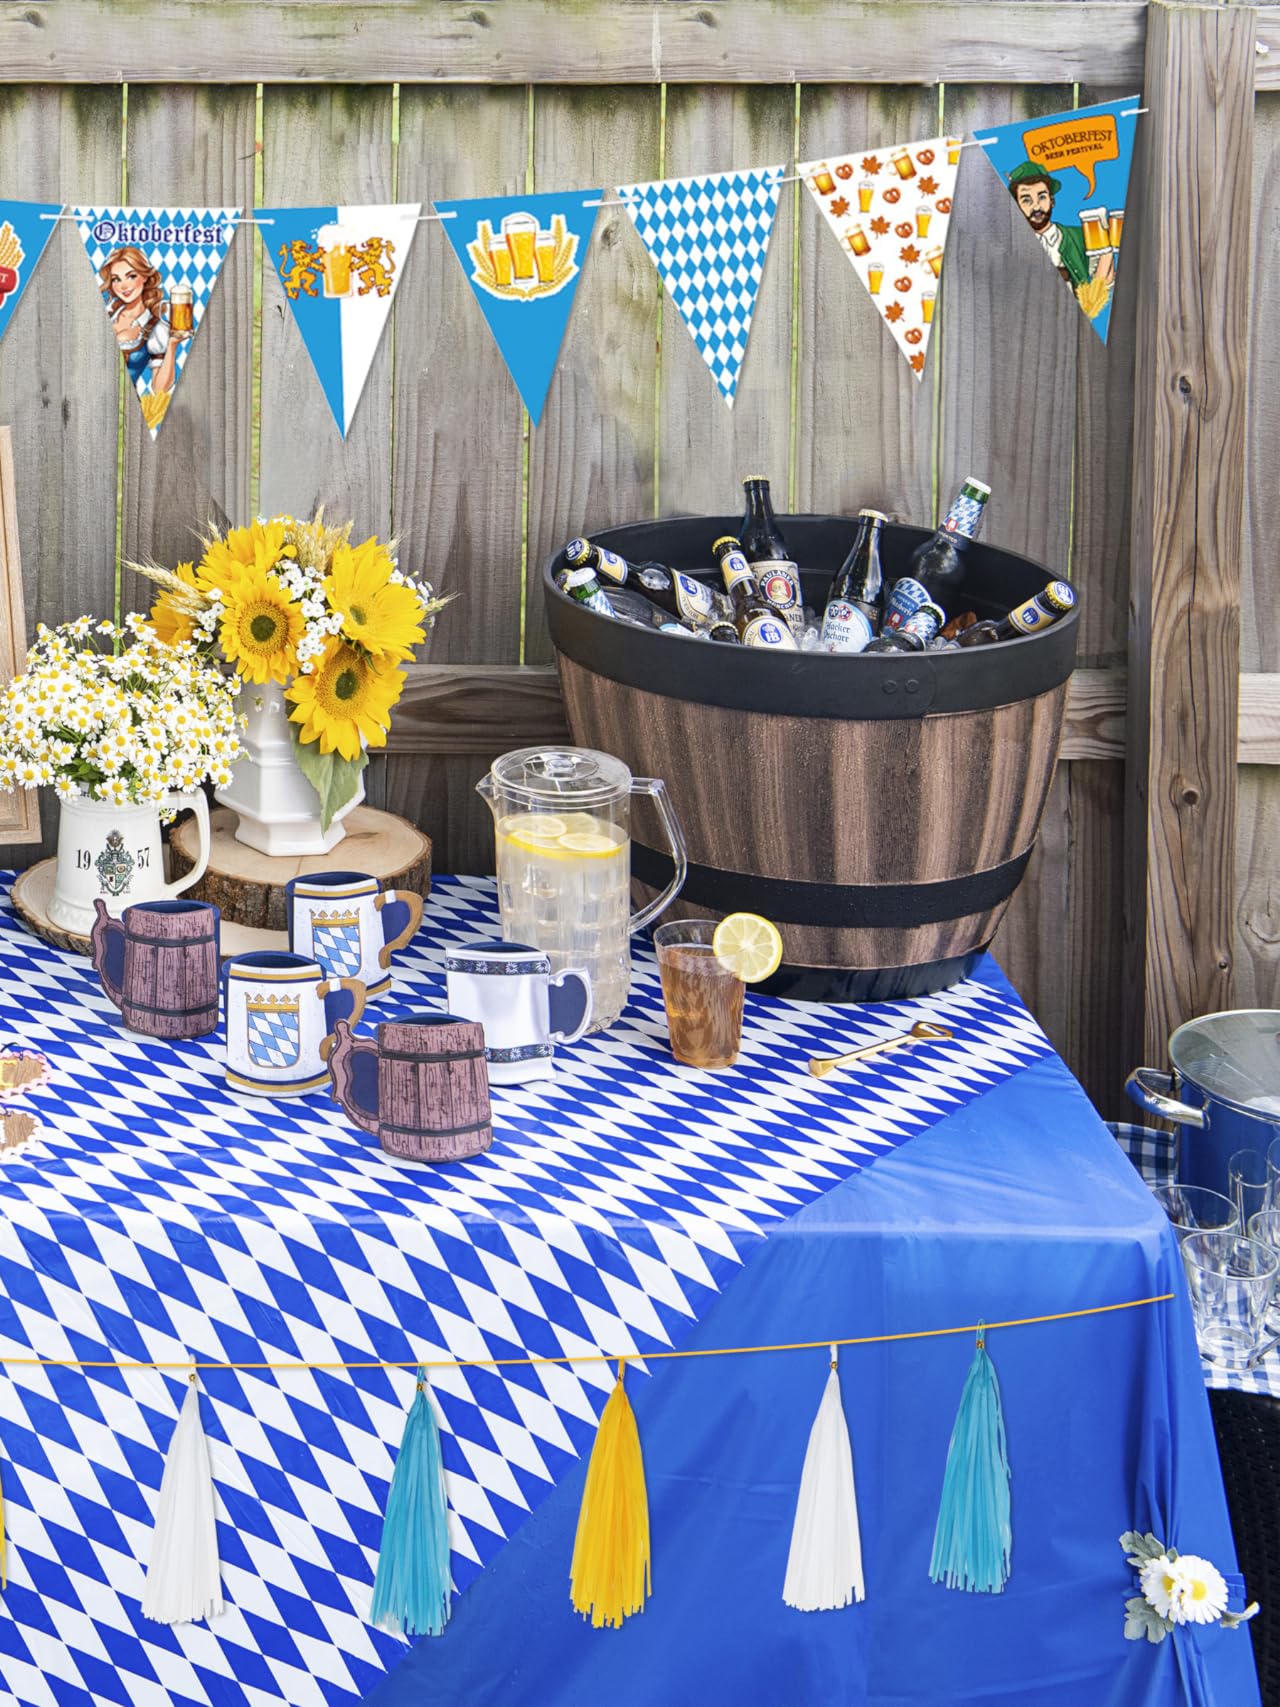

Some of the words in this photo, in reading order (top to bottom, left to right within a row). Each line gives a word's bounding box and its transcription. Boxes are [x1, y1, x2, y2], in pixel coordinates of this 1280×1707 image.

[1031, 129, 1112, 156] OKTOBERFEST
[94, 221, 223, 243] Oktoberfest
[760, 570, 795, 587] PAULANER
[75, 847, 92, 870] 19
[136, 845, 150, 870] 57
